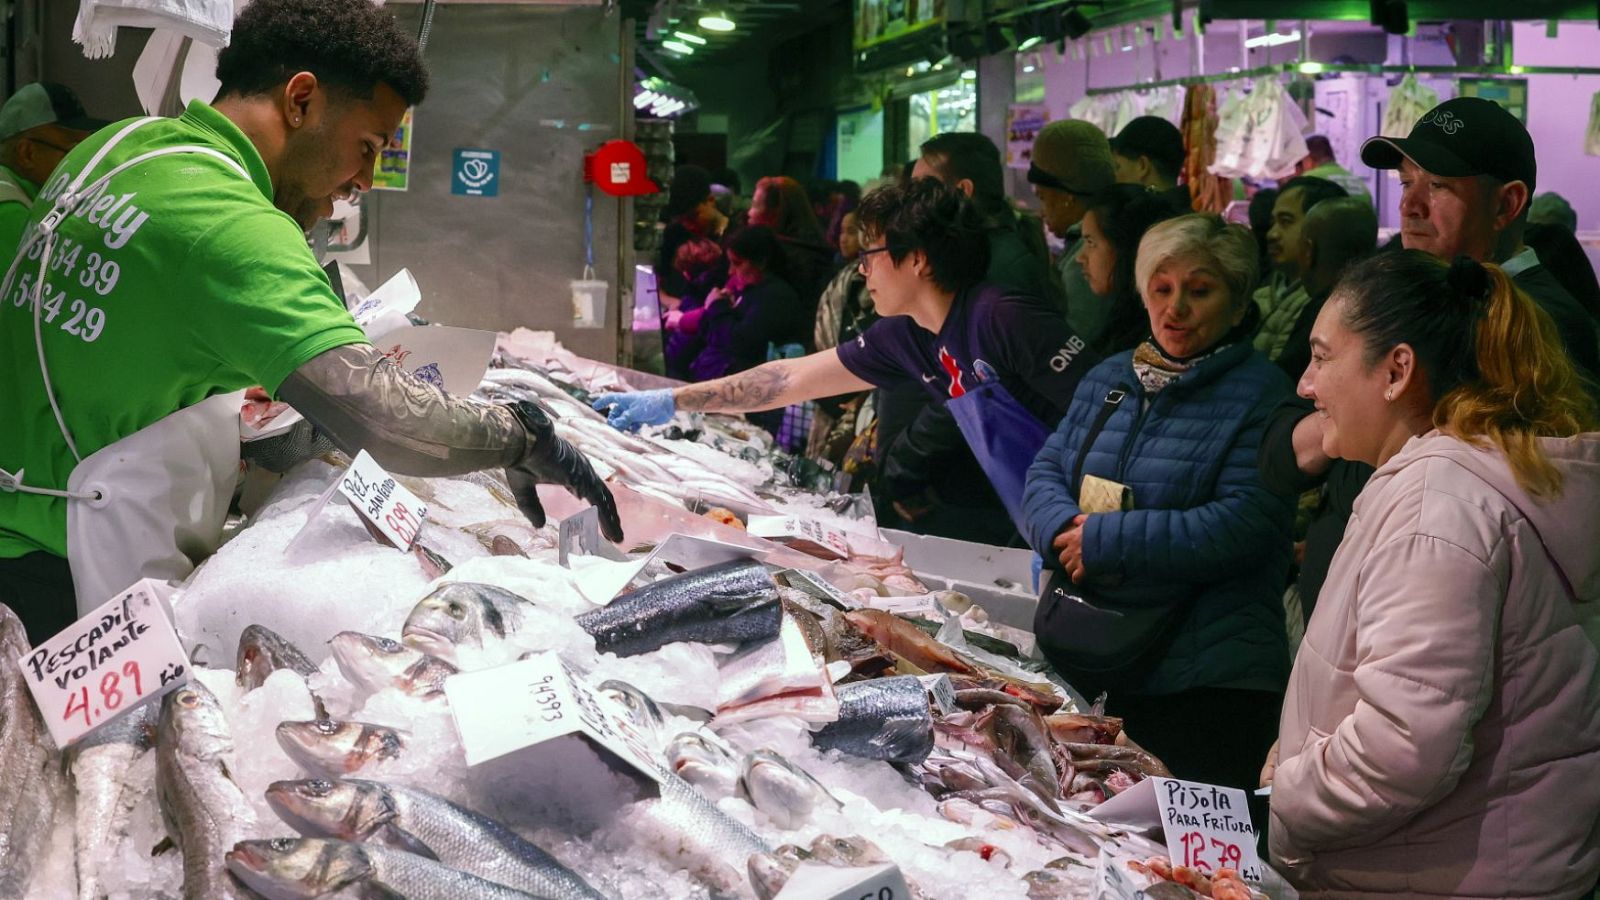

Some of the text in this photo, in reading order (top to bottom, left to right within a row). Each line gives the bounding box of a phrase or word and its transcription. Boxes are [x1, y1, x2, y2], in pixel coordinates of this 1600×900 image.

[79, 252, 121, 296] 39
[60, 298, 106, 343] 29
[1049, 335, 1086, 373] QNB
[343, 469, 370, 503] PEZ
[368, 494, 385, 520] SAN
[63, 660, 143, 727] 4.89
[1167, 806, 1201, 828] PARA
